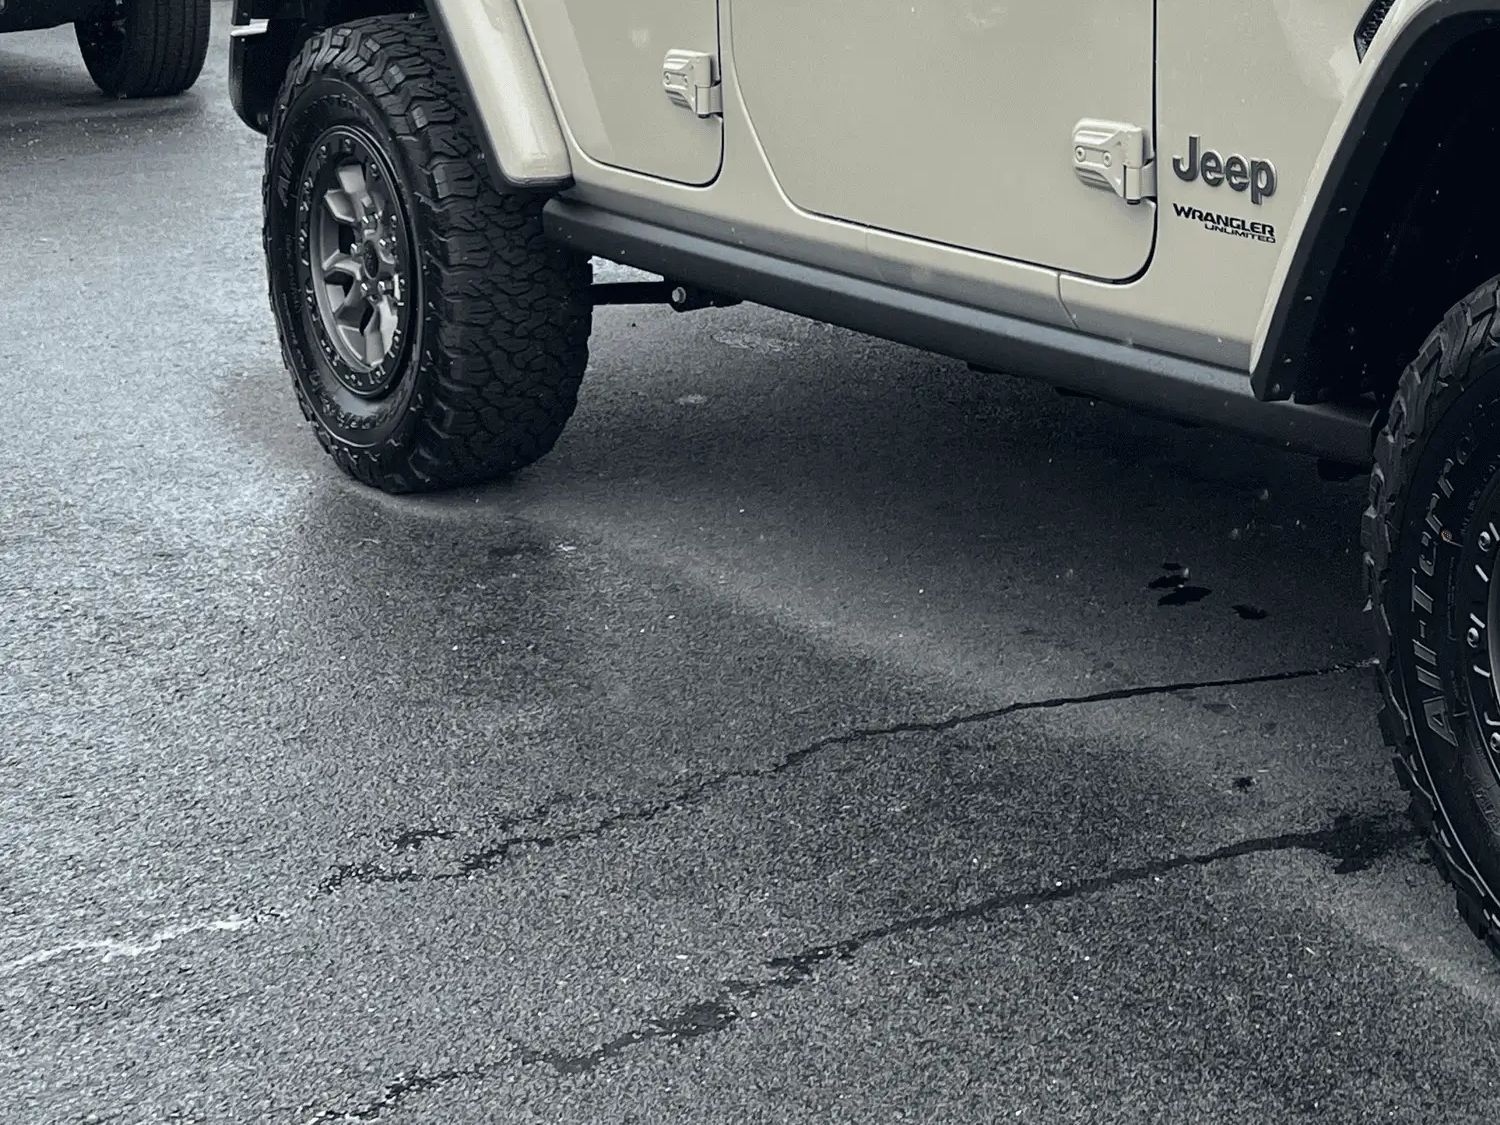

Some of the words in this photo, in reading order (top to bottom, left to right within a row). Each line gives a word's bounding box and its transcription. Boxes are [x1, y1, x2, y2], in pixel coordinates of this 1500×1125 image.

[1172, 134, 1278, 205] Jeep
[1172, 203, 1275, 237] WRANGLER
[1204, 223, 1276, 243] UNLIMITED
